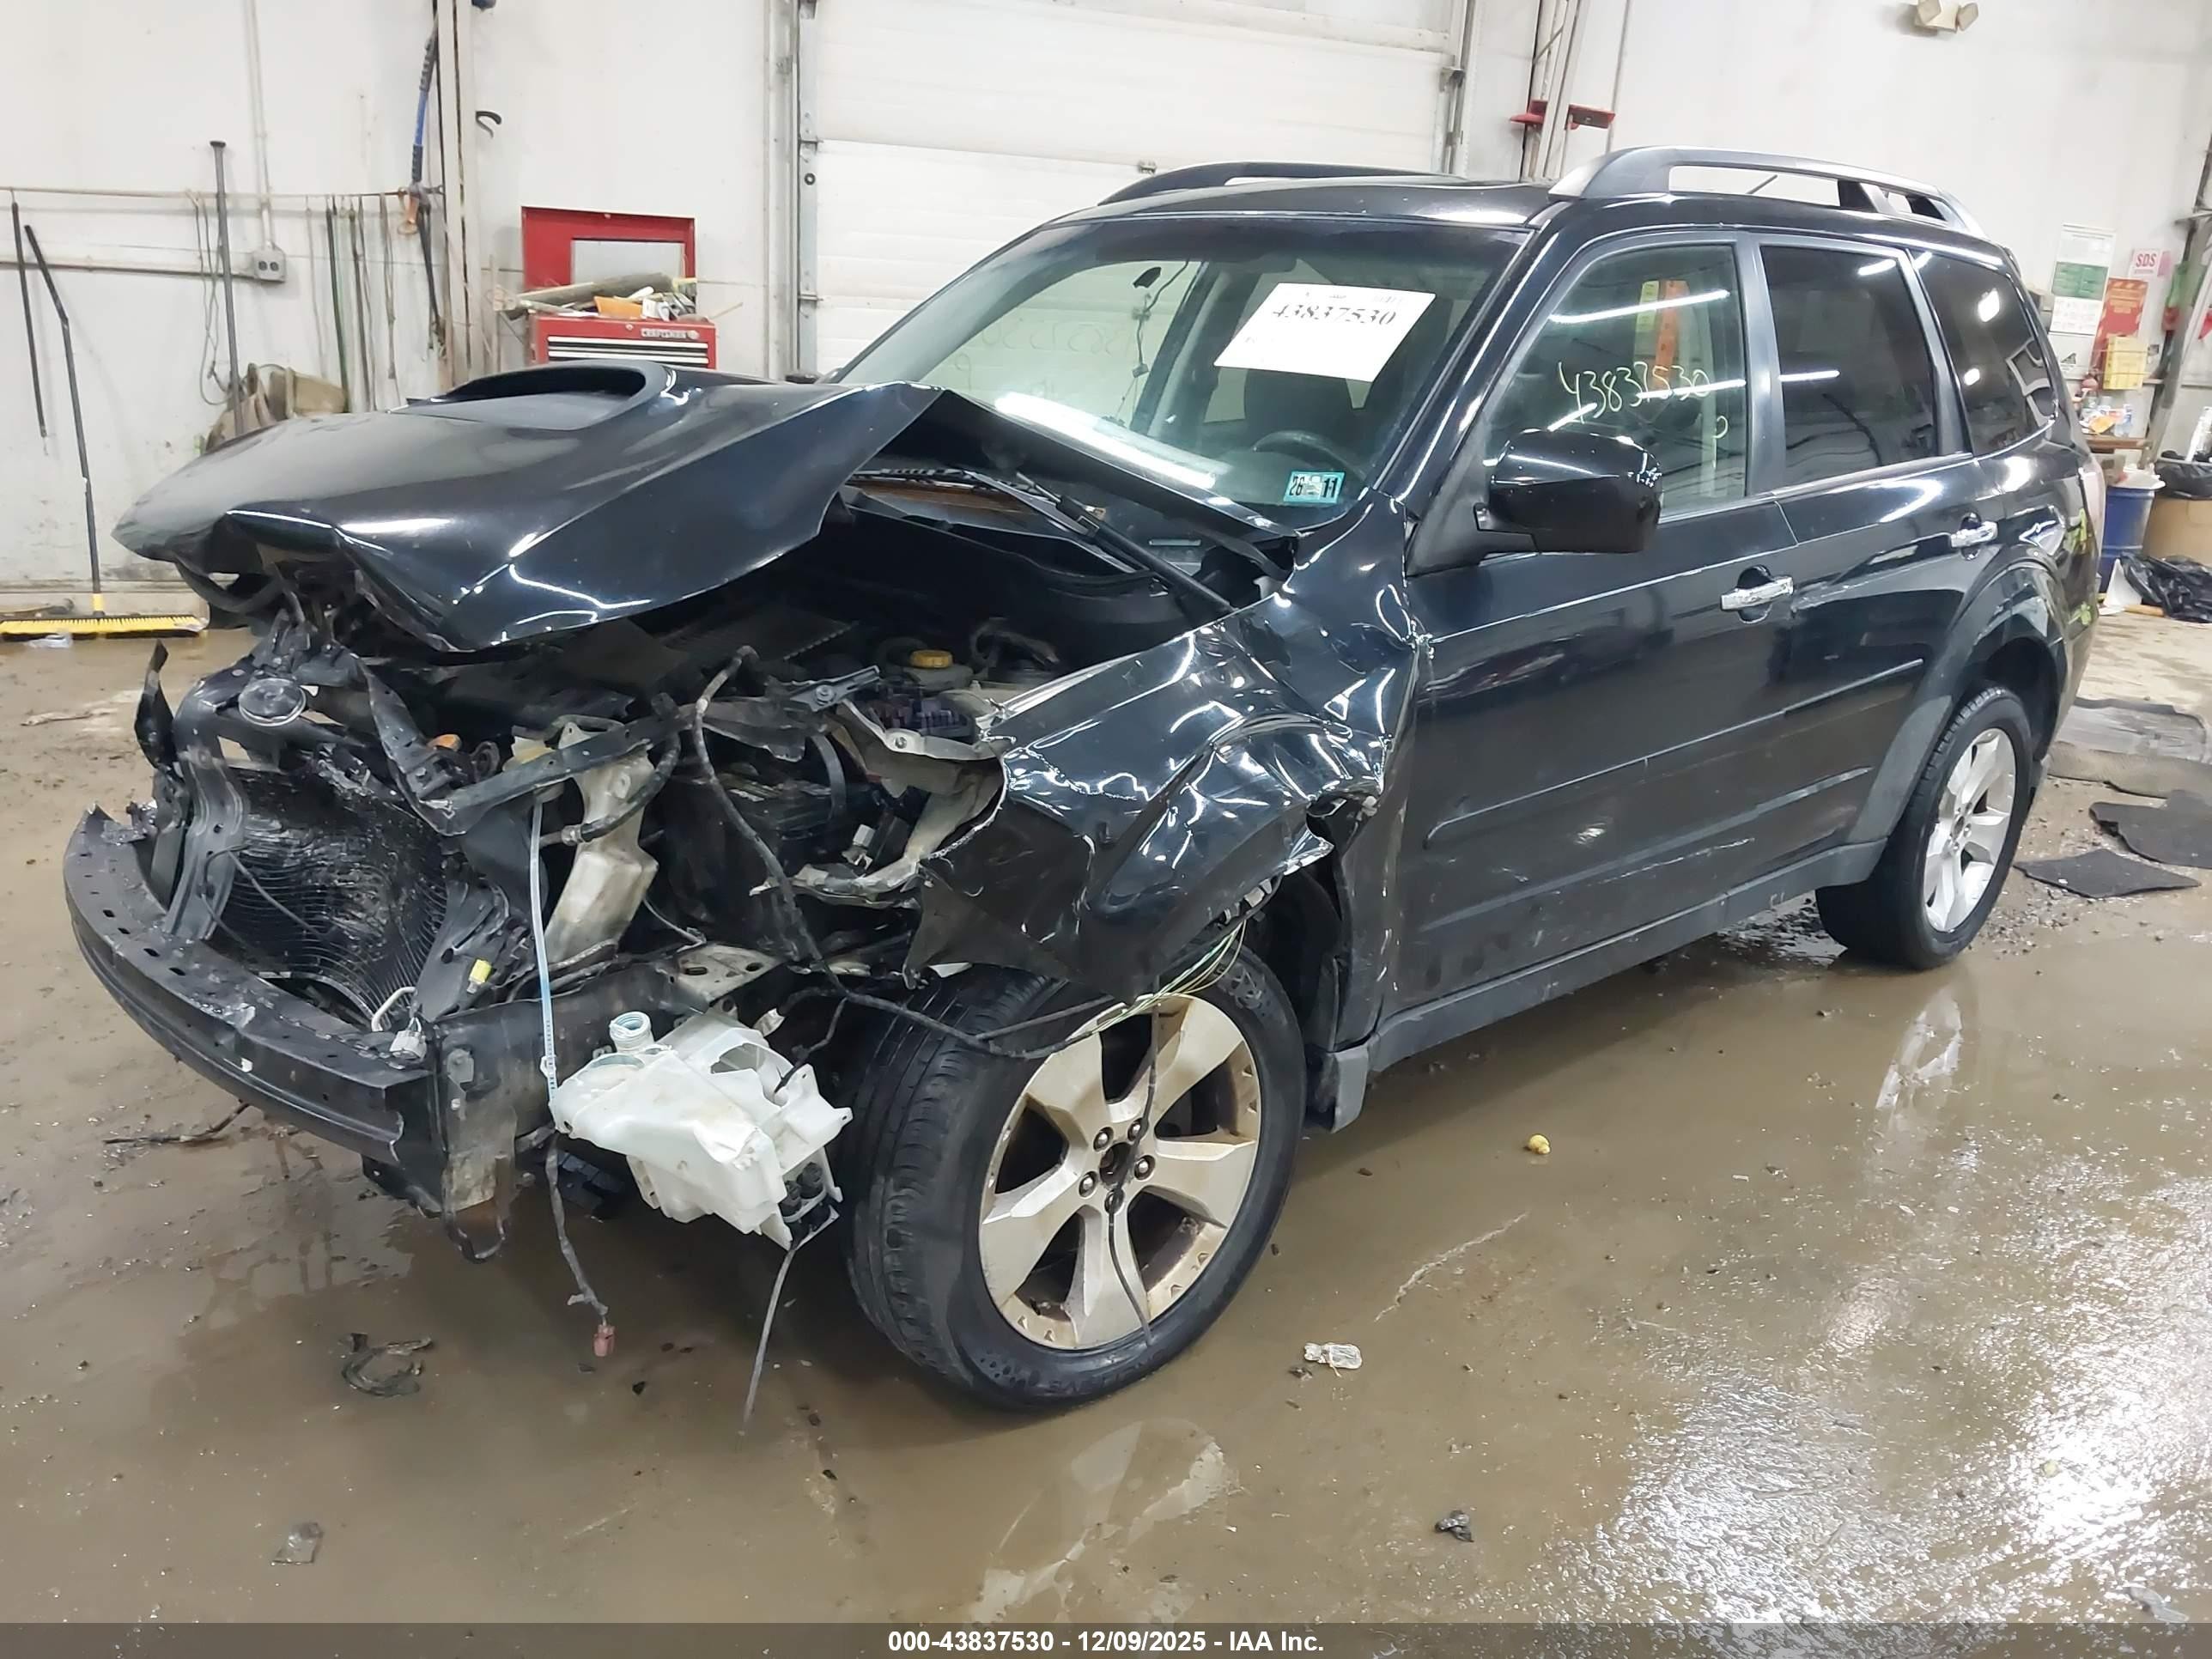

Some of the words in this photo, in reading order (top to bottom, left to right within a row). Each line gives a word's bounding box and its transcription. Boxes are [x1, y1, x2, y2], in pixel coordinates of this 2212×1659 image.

[2136, 253, 2157, 268] SDS
[1272, 302, 1398, 326] 43837530
[1559, 362, 1711, 424] 43837530
[1322, 478, 1339, 498] 11
